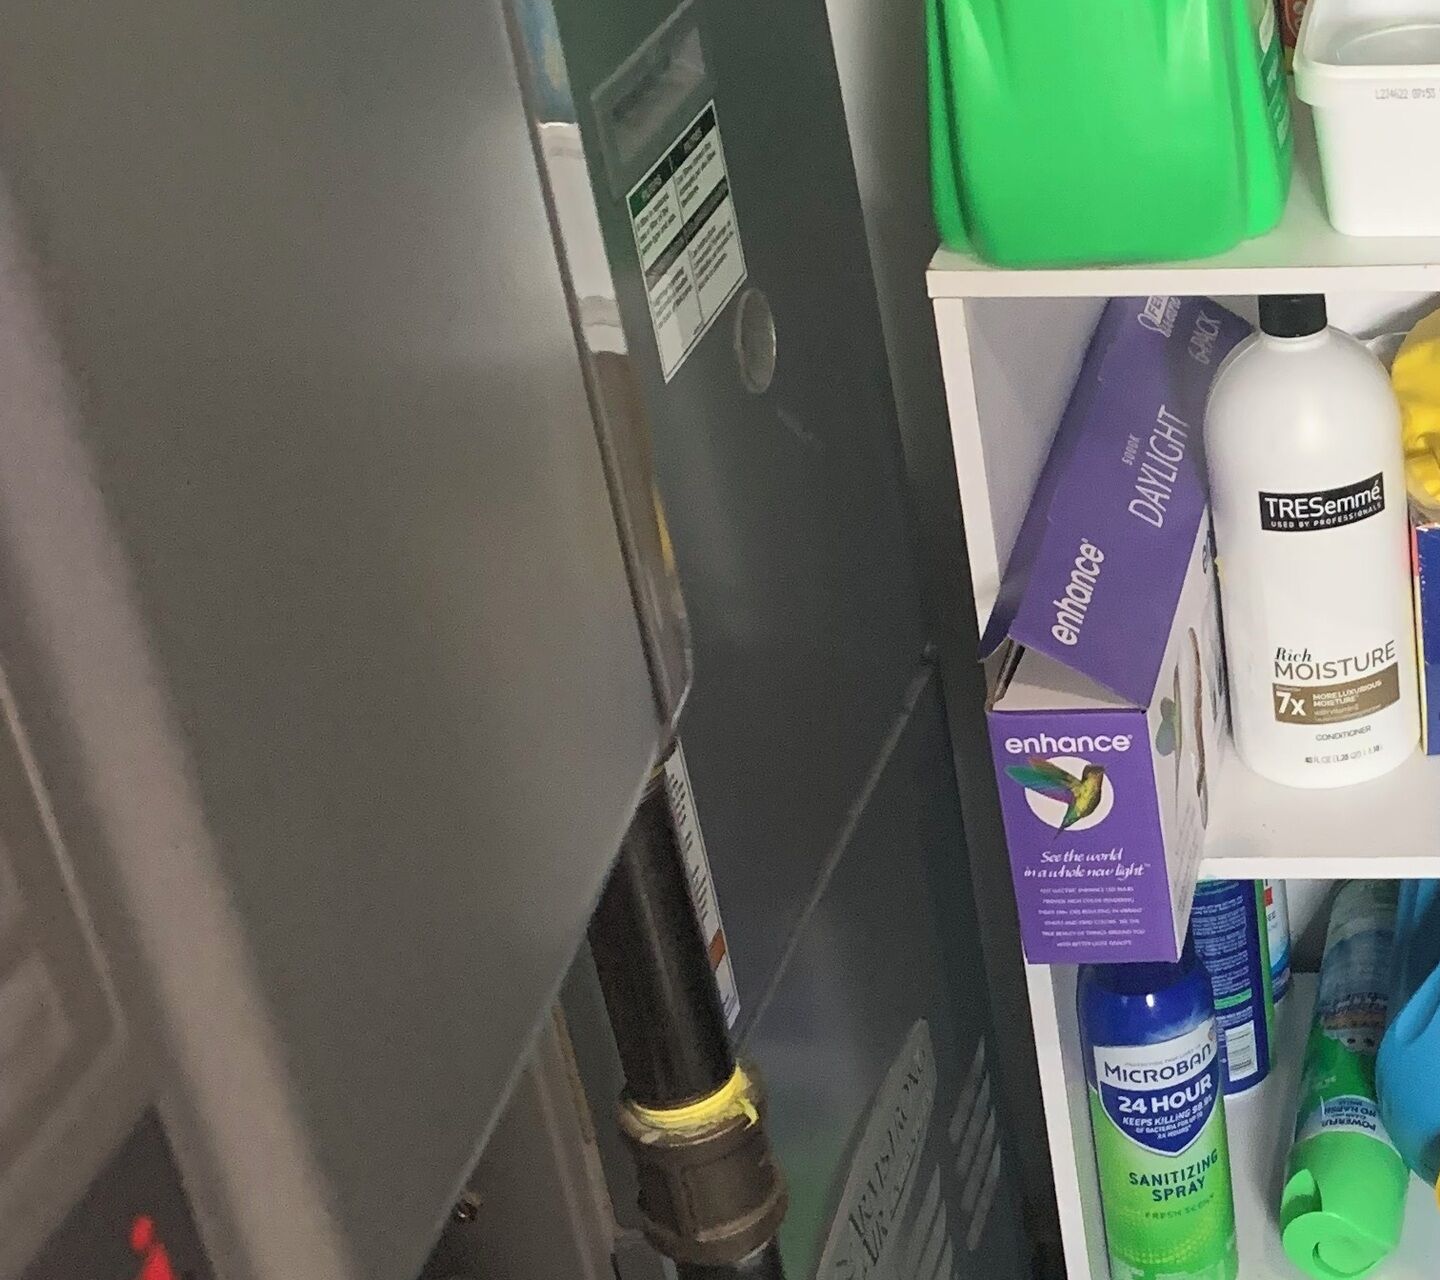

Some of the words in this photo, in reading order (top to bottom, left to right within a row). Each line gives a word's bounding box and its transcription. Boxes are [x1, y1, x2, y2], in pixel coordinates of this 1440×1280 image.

[1128, 404, 1190, 528] DAYLIGHT
[1264, 479, 1381, 519] TRESemmé
[1270, 520, 1295, 528] USED
[1298, 520, 1310, 528] BY
[1313, 502, 1382, 527] PROFESSIONALS
[1051, 540, 1105, 646] enhance
[1274, 647, 1313, 662] Rich
[1274, 639, 1396, 681] MOISTURE
[1275, 690, 1306, 716] 7x
[1312, 693, 1338, 701] MORE
[1338, 680, 1383, 699] LUXURIOUS
[1004, 733, 1131, 754] enhance
[1315, 724, 1372, 742] CONDITIONER
[1040, 850, 1062, 864] See
[1063, 849, 1085, 863] the
[1086, 847, 1124, 862] world
[1023, 866, 1038, 878] in
[1048, 864, 1084, 879] whole
[1087, 868, 1115, 878] new
[1115, 862, 1145, 881] light
[1104, 1042, 1212, 1084] MICROBAN
[1117, 1095, 1148, 1114] 24
[1151, 1073, 1213, 1114] HOUR
[1122, 1116, 1153, 1127] KEEPS
[1154, 1108, 1191, 1126] KILLING
[1128, 1148, 1218, 1187] SANITIZING
[1152, 1175, 1206, 1203] SPRAY
[1144, 1207, 1183, 1220] FRESH
